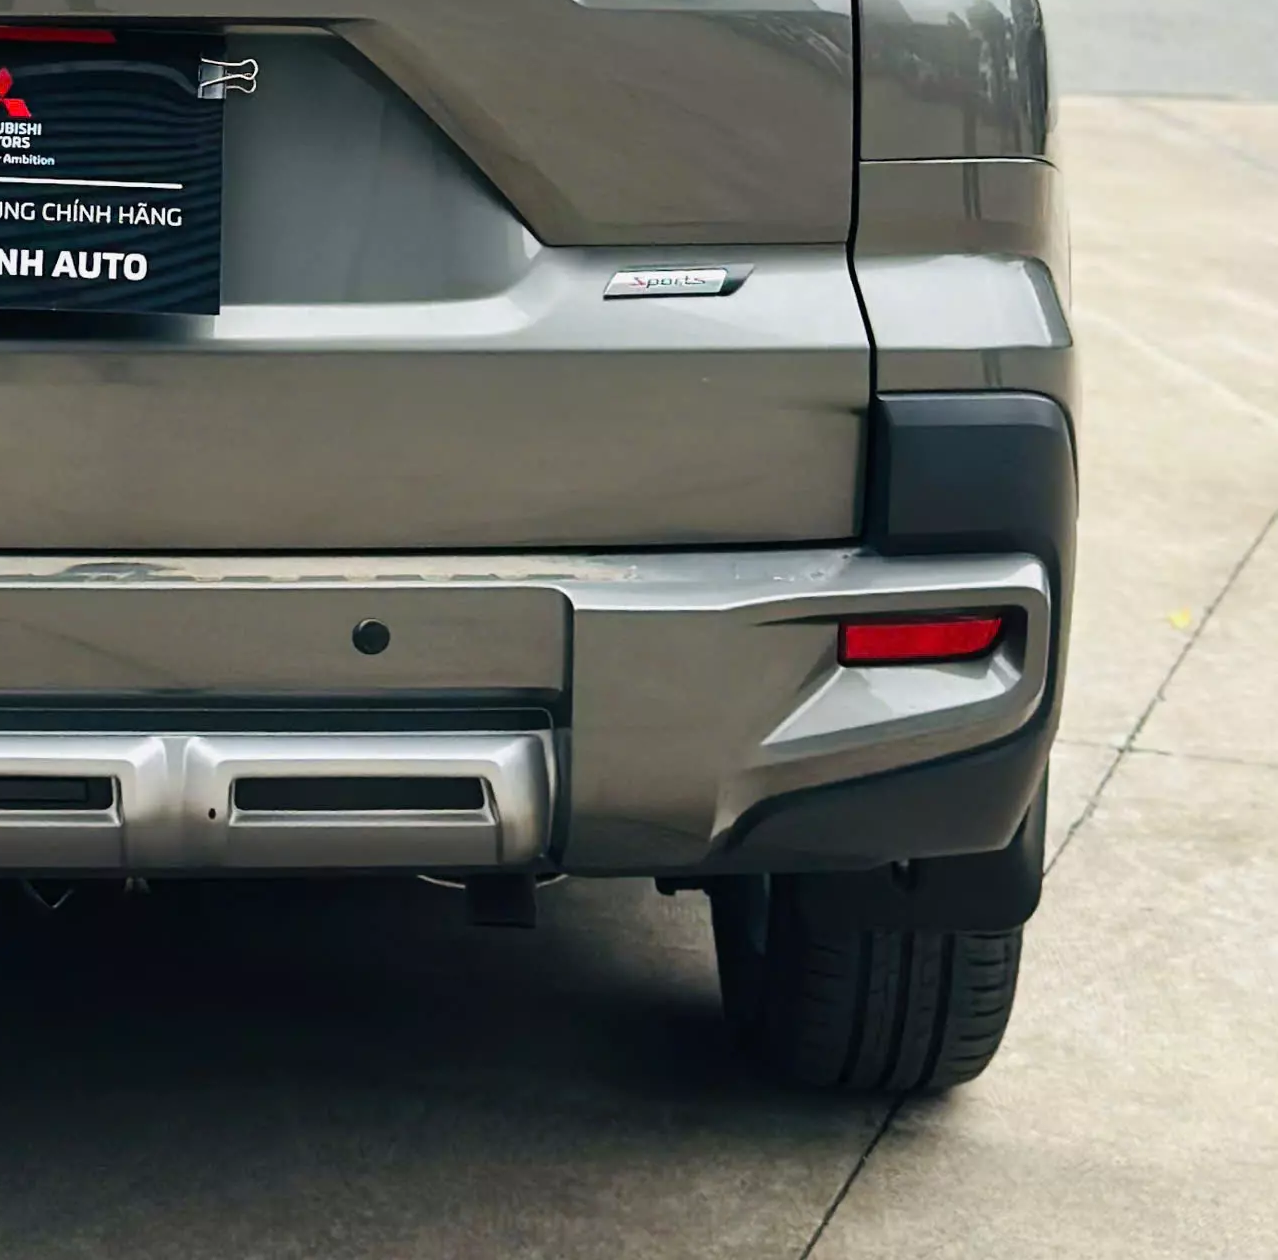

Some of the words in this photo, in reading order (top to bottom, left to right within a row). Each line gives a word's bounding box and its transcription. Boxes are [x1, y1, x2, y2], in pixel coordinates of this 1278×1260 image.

[3, 153, 55, 166] Ambition
[41, 198, 112, 224] CHÍNH
[118, 202, 183, 227] HÃNG
[51, 250, 148, 281] AUTO
[630, 275, 707, 289] Sports
